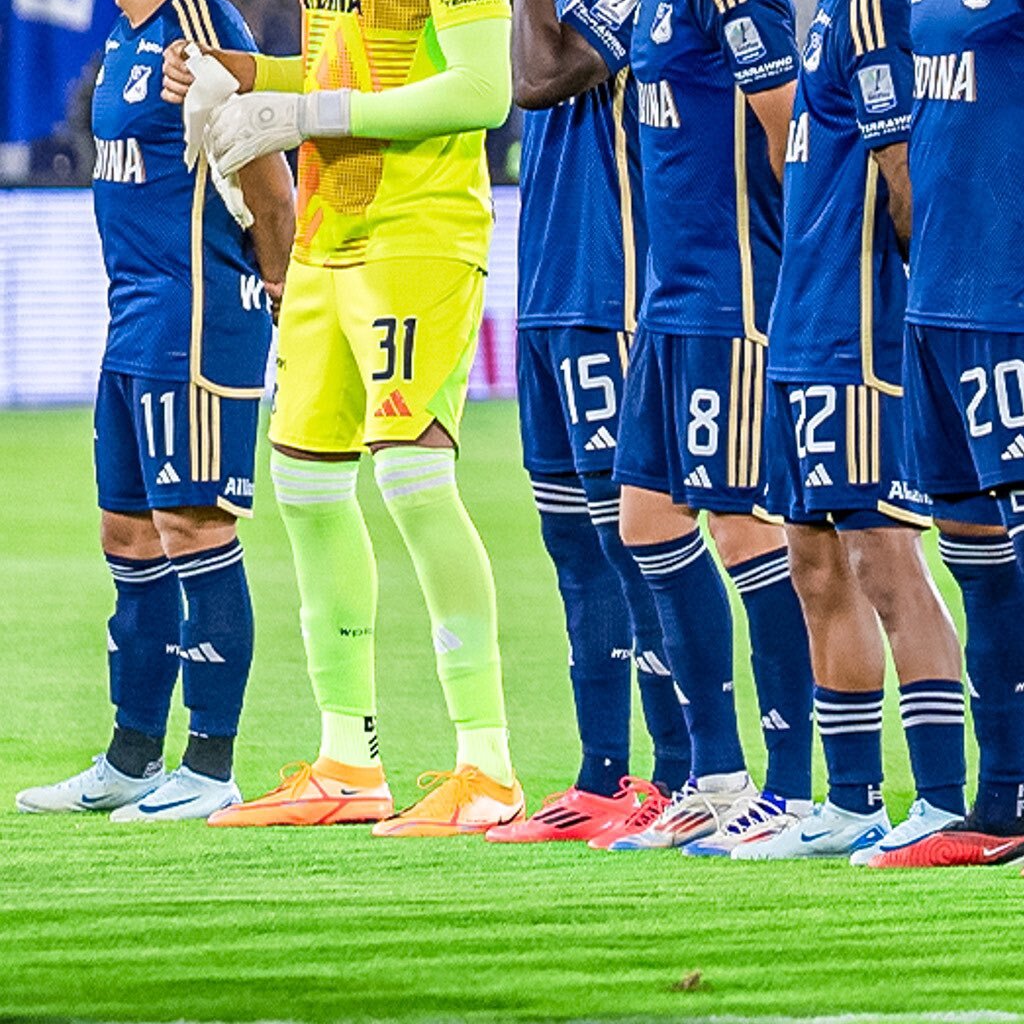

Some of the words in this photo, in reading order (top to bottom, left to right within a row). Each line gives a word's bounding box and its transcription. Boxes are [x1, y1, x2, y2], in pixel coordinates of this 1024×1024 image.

[371, 317, 417, 381] 31
[560, 353, 617, 425] 15
[140, 391, 176, 458] 11
[688, 389, 721, 457] 8
